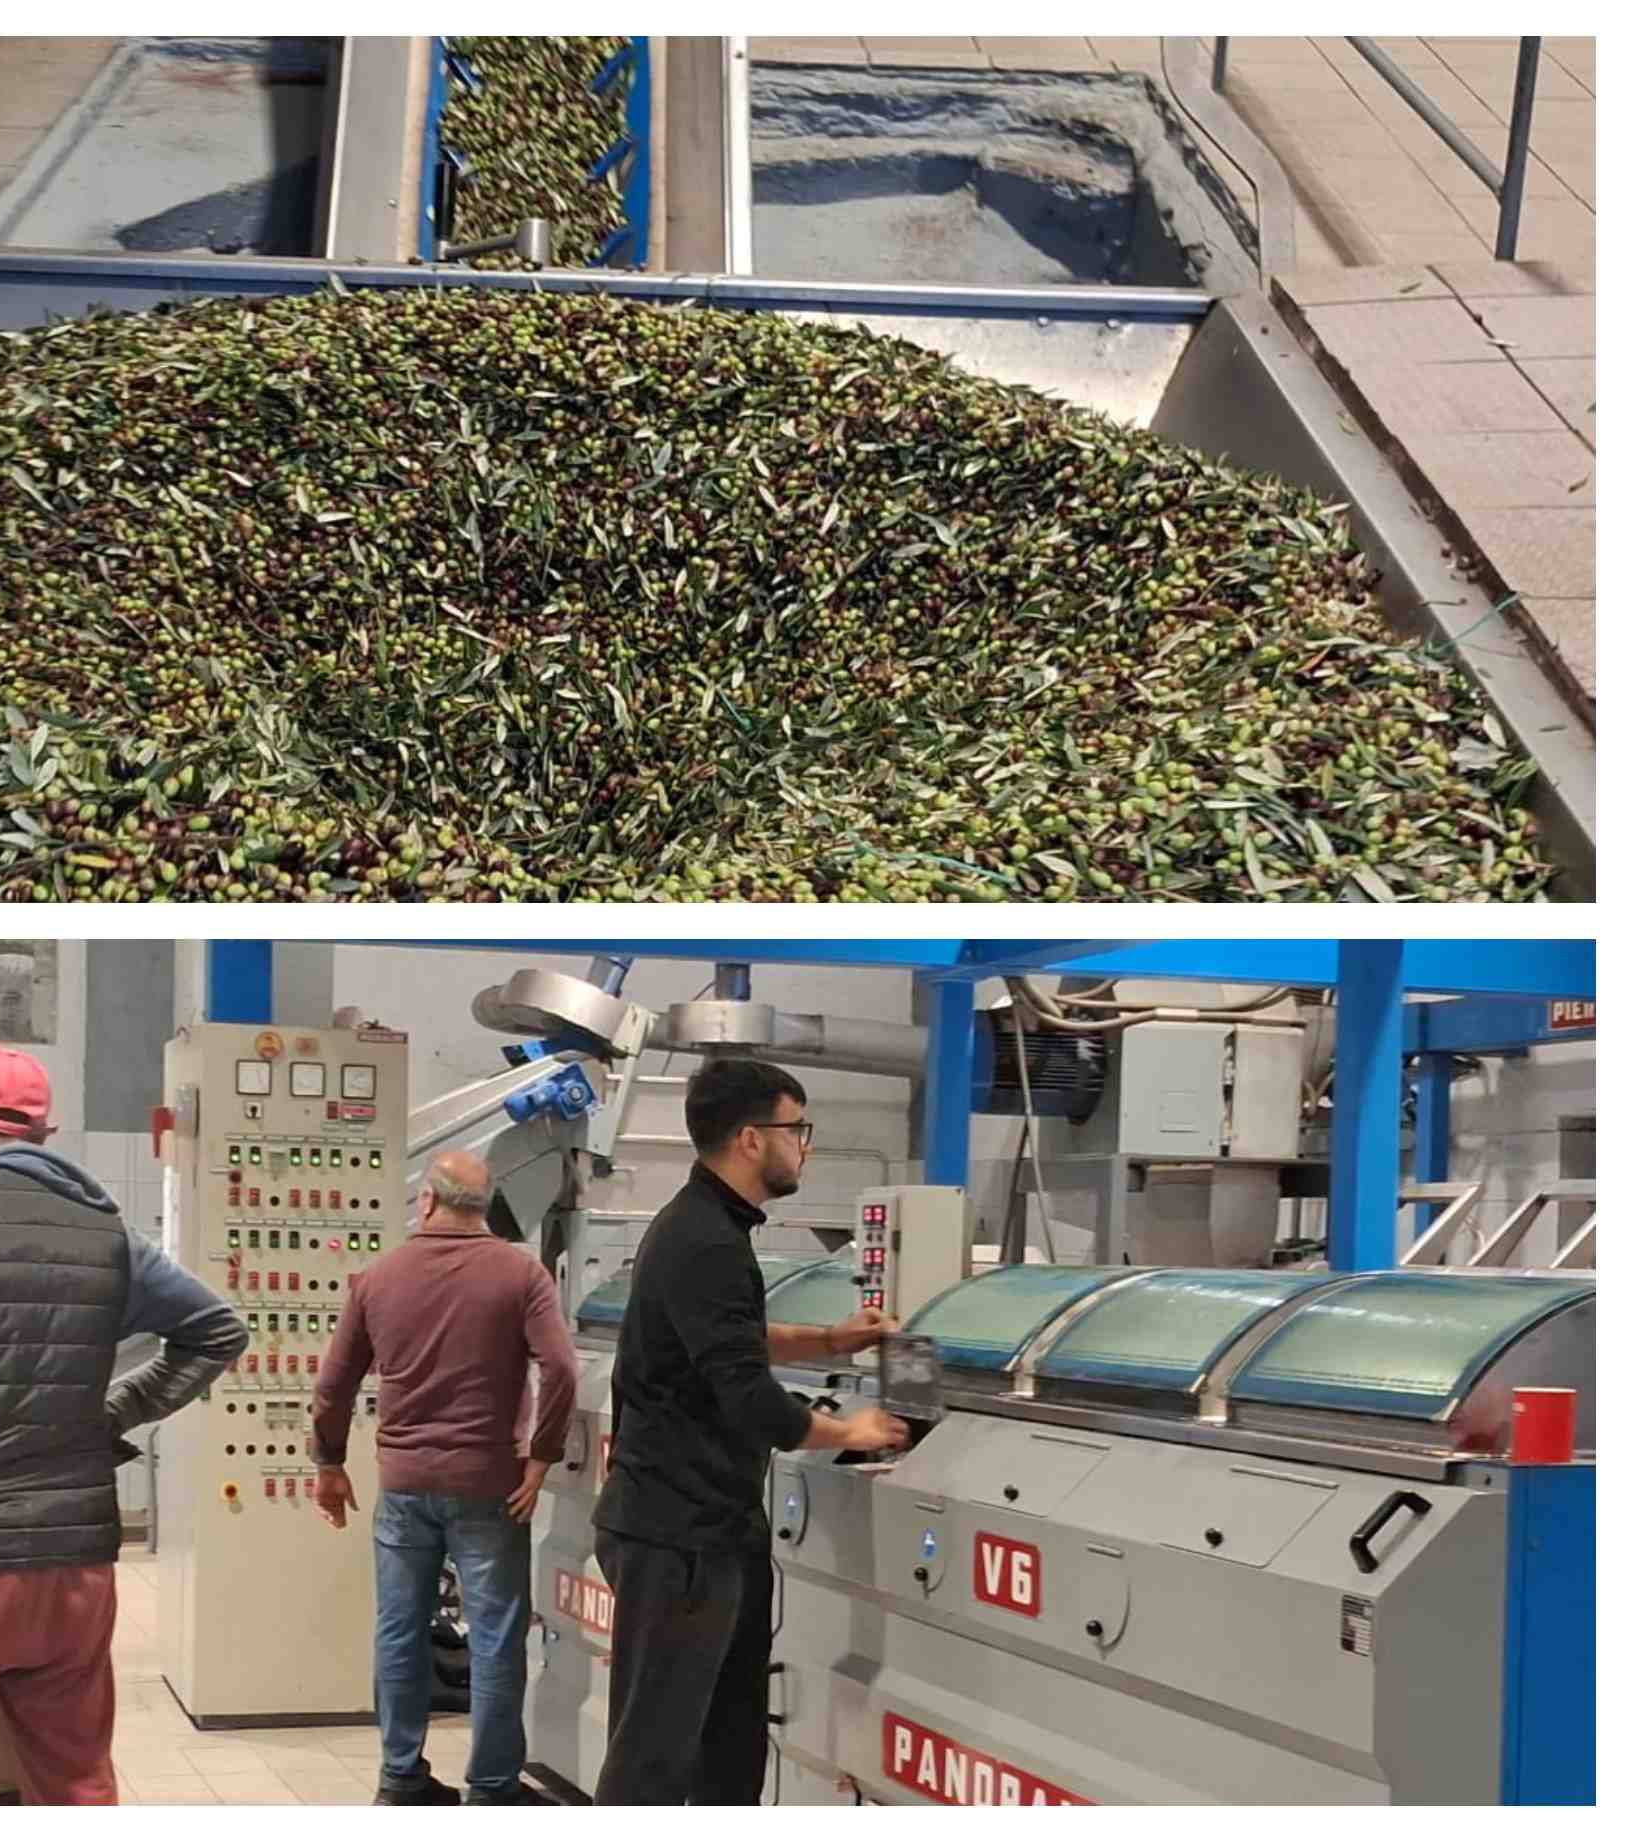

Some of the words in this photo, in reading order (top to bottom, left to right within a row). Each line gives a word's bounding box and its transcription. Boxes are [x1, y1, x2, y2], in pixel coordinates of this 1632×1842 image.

[559, 1573, 616, 1634] PANO
[982, 1541, 1032, 1605] V6
[894, 1725, 1072, 1806] PANOR
